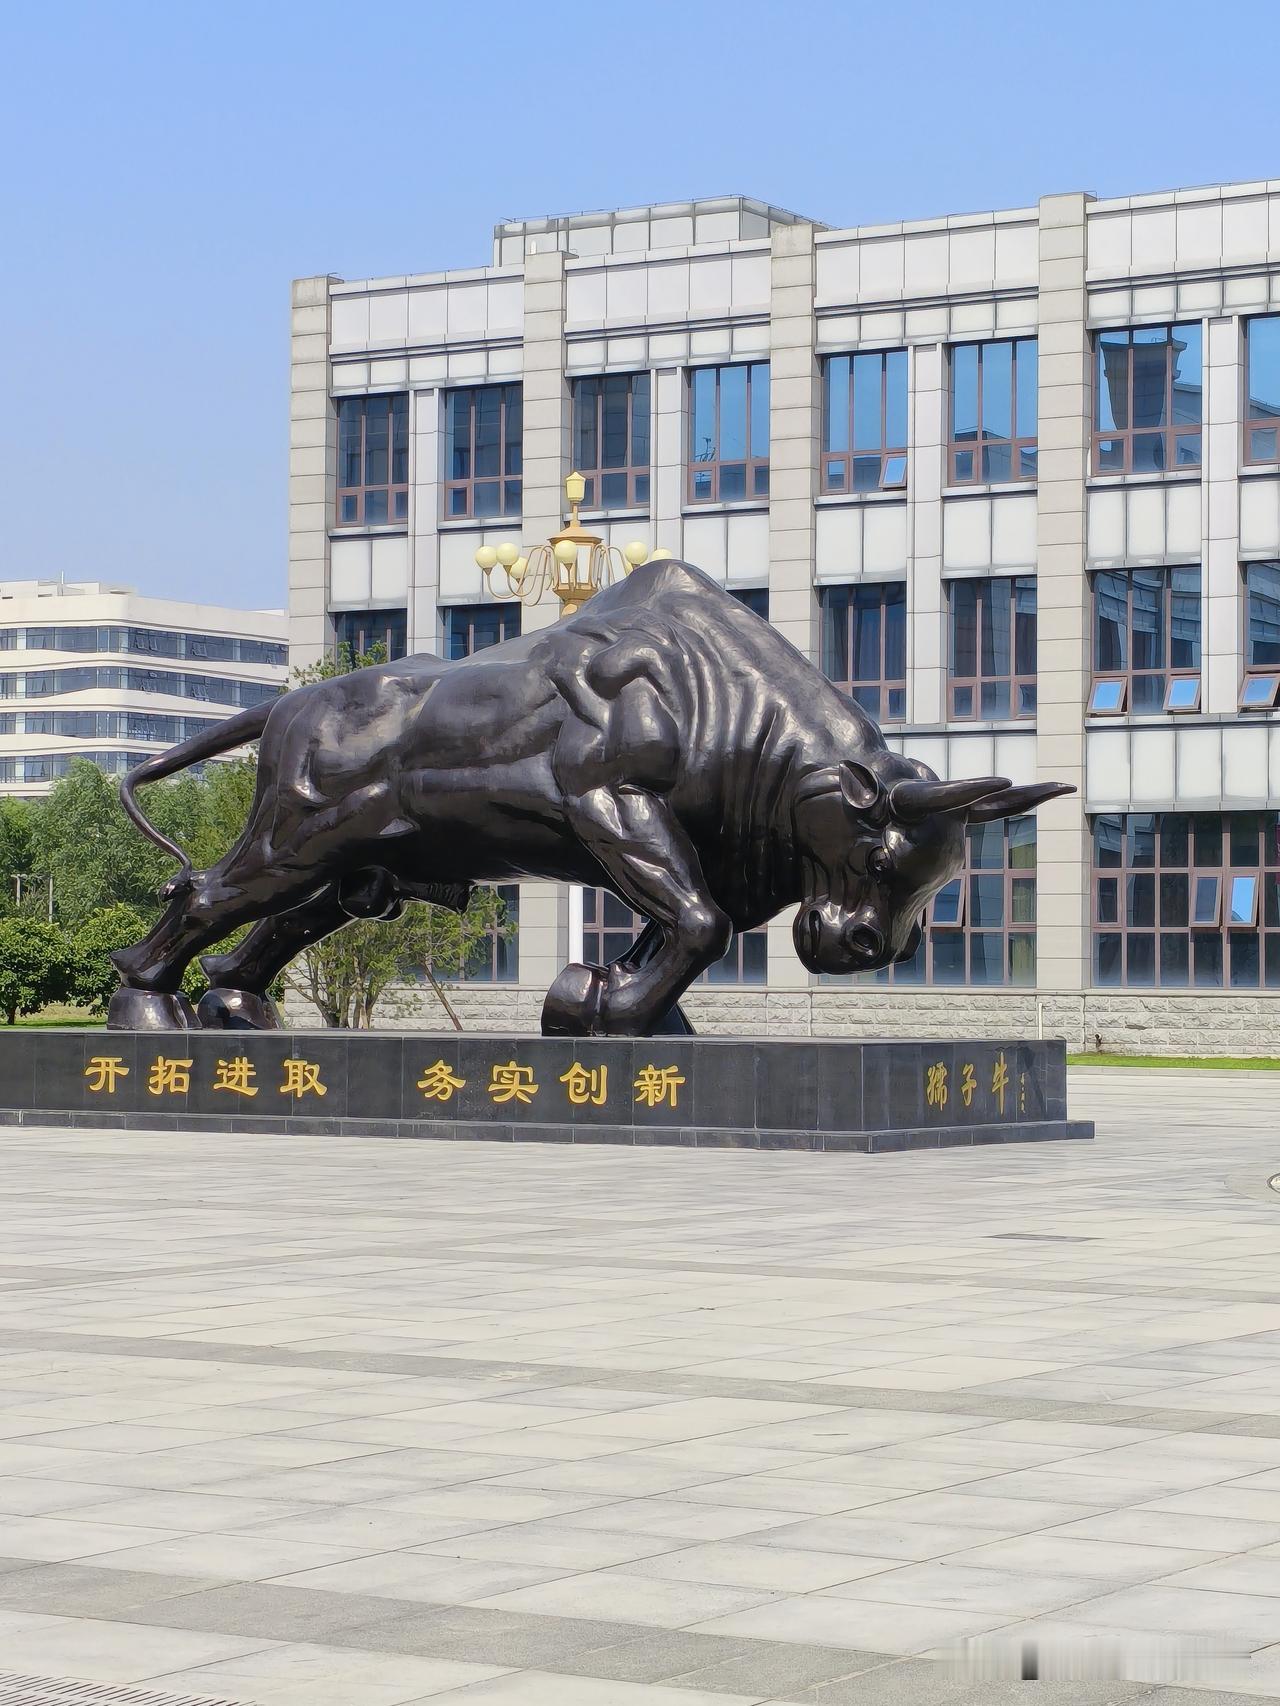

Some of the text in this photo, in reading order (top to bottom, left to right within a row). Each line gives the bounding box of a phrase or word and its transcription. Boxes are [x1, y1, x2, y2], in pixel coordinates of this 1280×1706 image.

[84, 1055, 686, 1107] 开拓进取 务实创新
[926, 1051, 1009, 1115] 孺子牛
